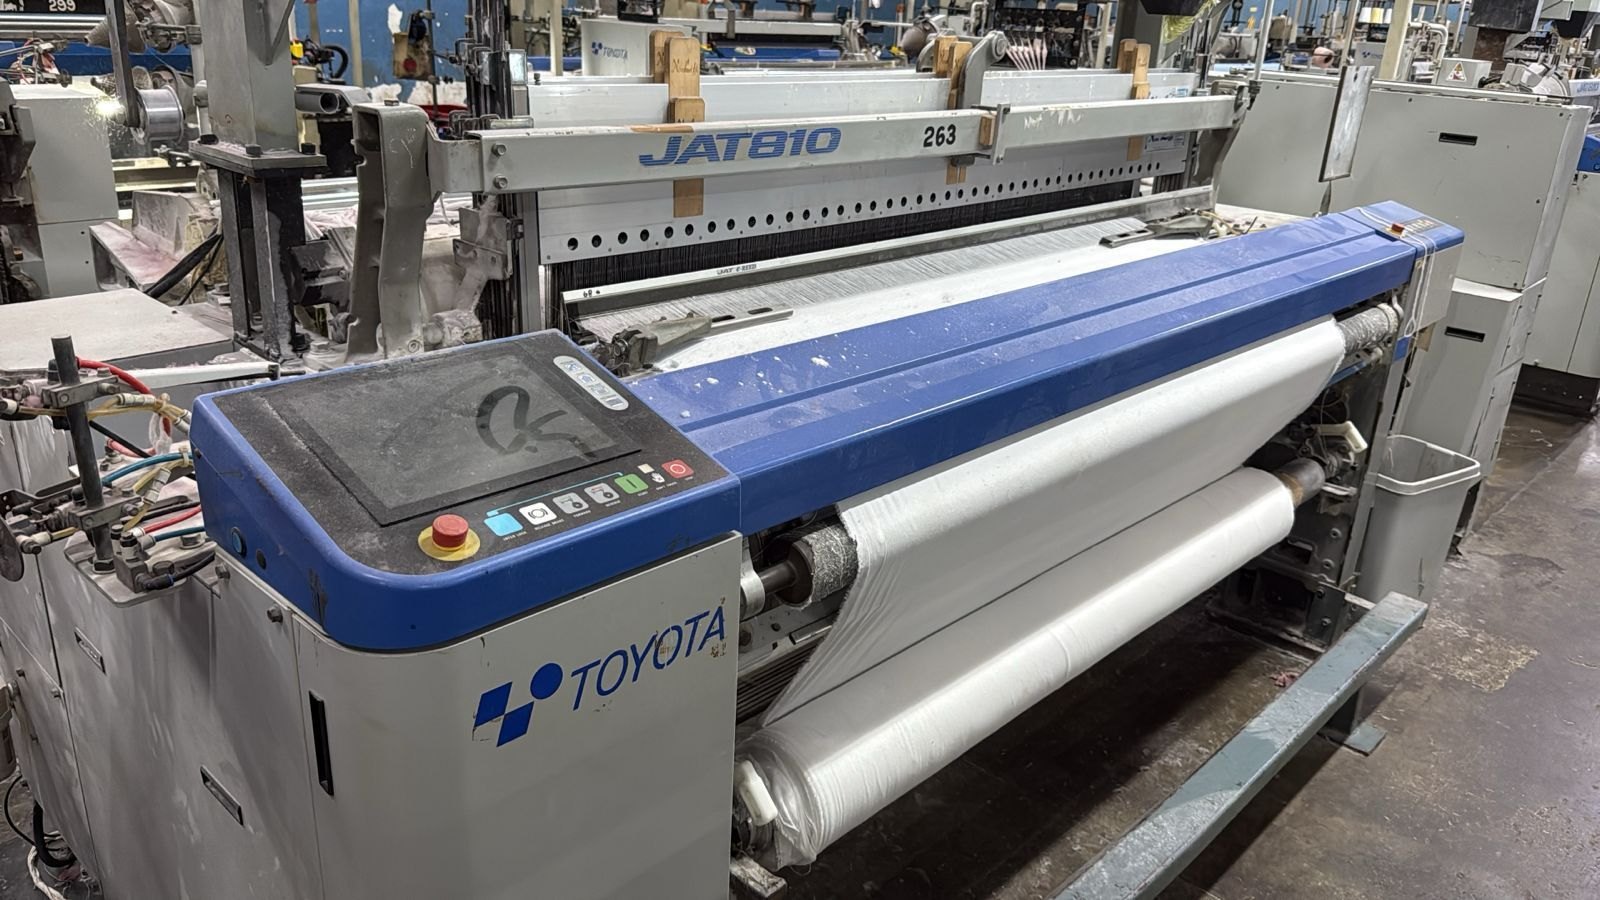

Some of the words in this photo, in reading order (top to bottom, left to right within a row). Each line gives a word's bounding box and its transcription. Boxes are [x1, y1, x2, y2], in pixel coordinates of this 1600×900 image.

[48, 0, 77, 12] 299
[639, 127, 842, 167] JAT810
[923, 123, 957, 148] 263
[570, 605, 726, 712] TOYOTA
